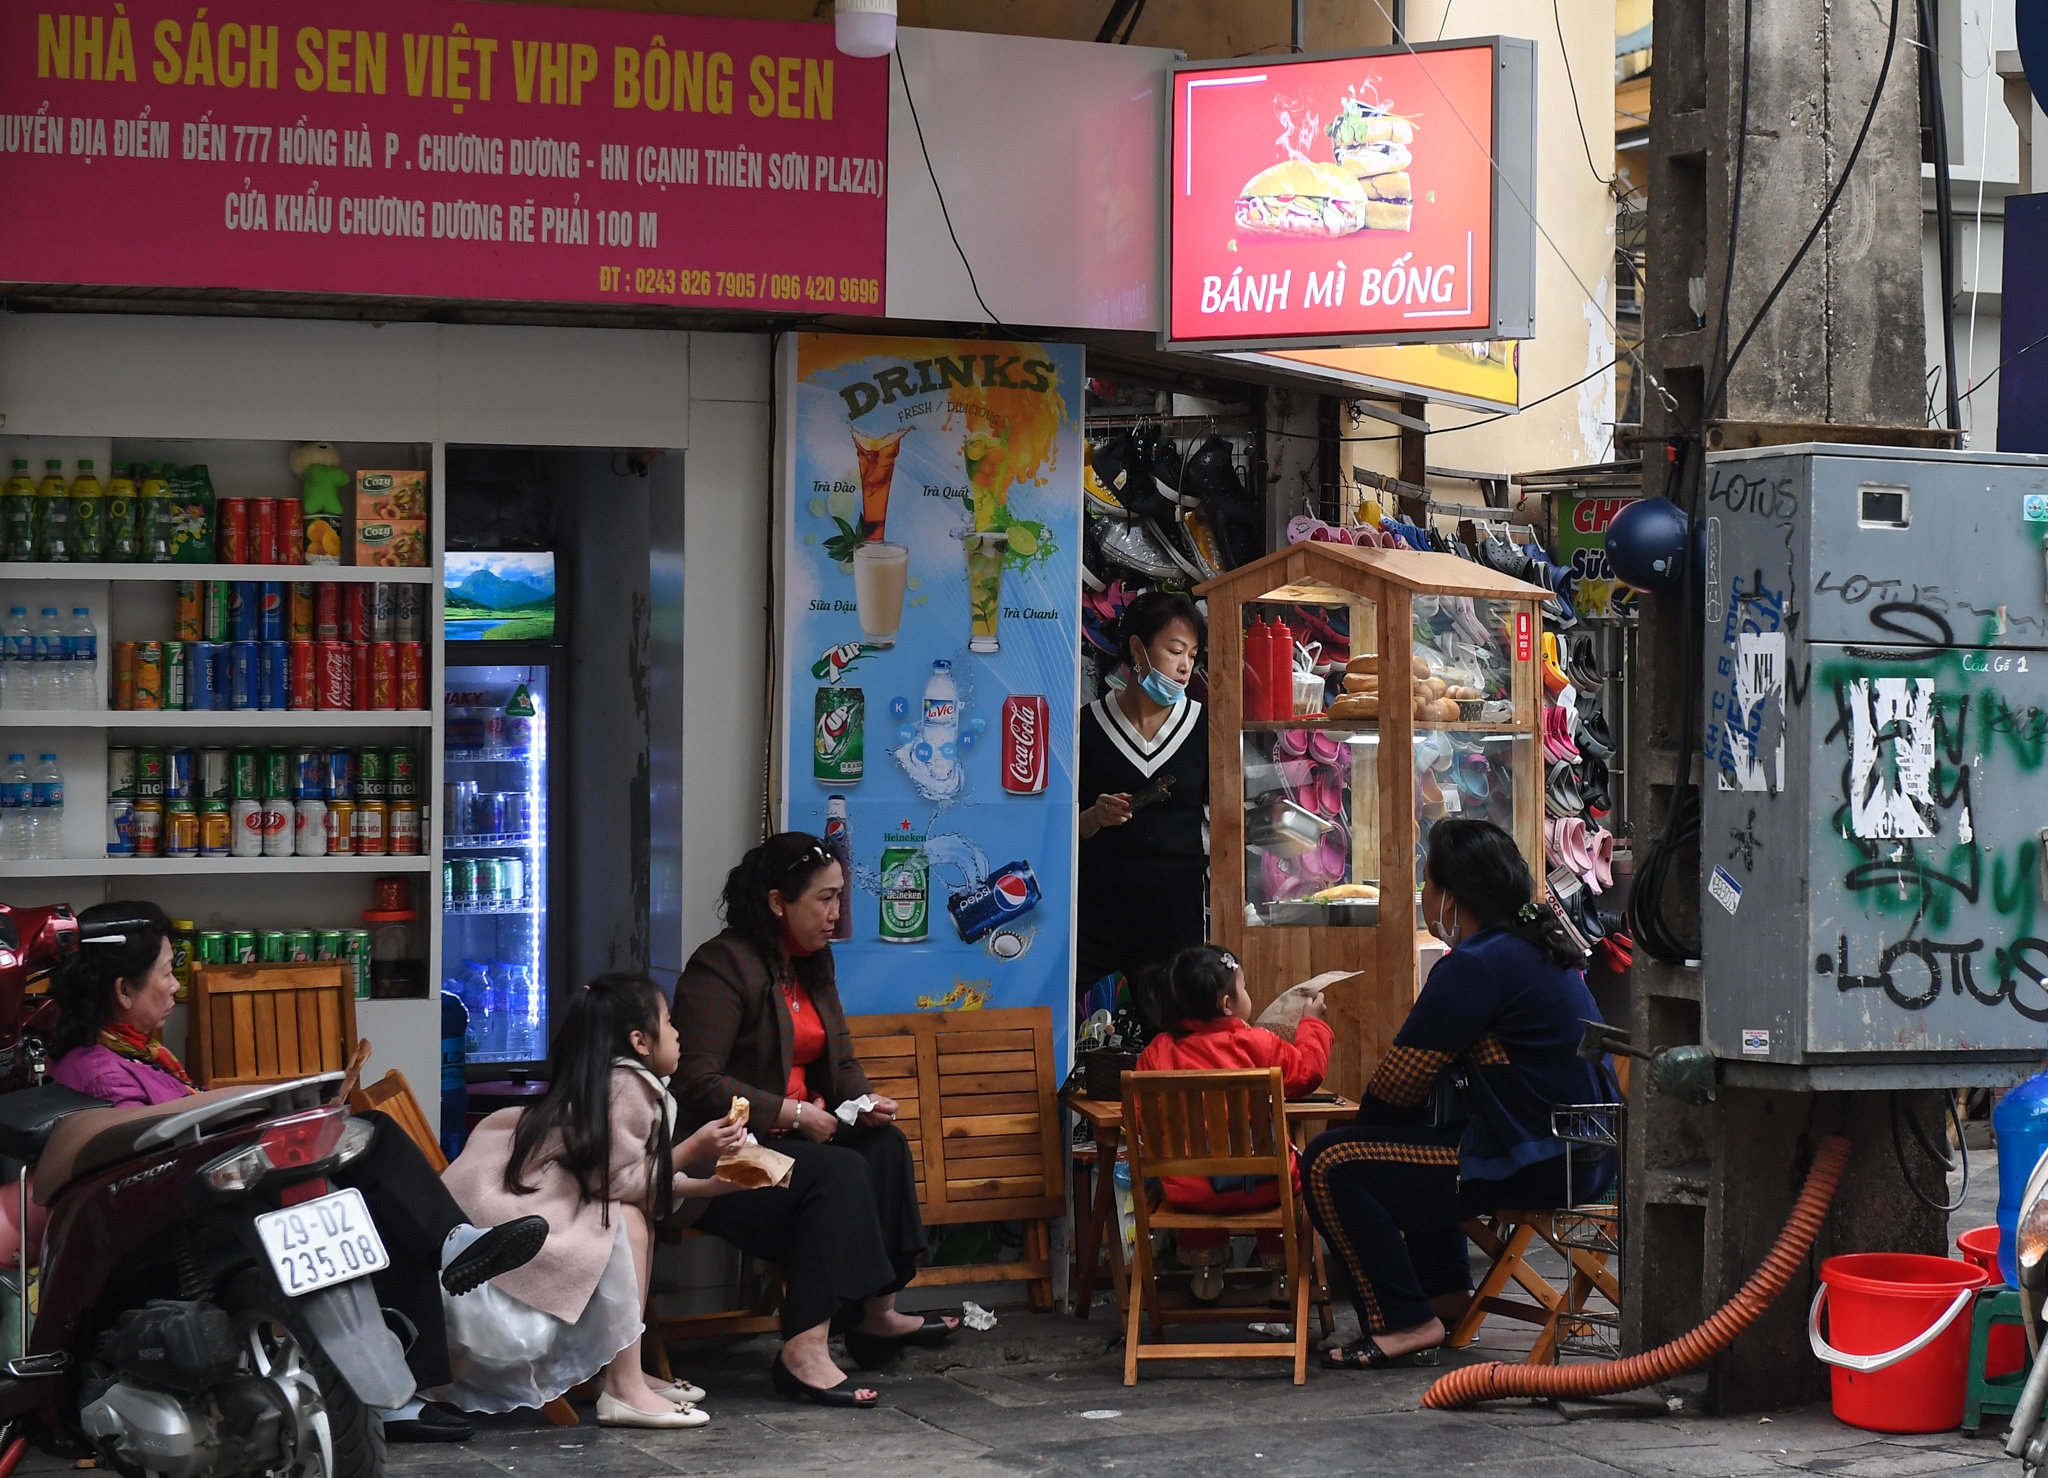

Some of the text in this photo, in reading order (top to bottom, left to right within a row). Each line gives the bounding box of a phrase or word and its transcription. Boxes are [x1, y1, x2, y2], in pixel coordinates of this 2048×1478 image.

[38, 3, 834, 121] NHÀ SÁCH SEN VIỆT VHP BÔNG SEN
[70, 117, 107, 165] ĐỊA
[113, 105, 170, 159] ĐIỂM
[182, 110, 227, 162] ĐẾN
[232, 126, 272, 163] 777
[279, 114, 337, 168] HỒNG
[344, 123, 373, 168] HÀ
[385, 132, 399, 169] P
[418, 133, 503, 176] CHƯƠNG
[510, 136, 580, 179] DƯƠNG
[600, 144, 630, 182] HN
[636, 145, 699, 192] (CẠNH
[705, 143, 762, 189] THIÊN
[768, 149, 809, 191] SƠN
[815, 155, 884, 198] PLAZA)
[225, 177, 658, 248] CỬA KHẨU CHƯƠNG DƯƠNG RẼ PHẢI 100 M
[599, 265, 621, 292] ĐT
[636, 268, 677, 296] 0243
[680, 271, 711, 297] 826
[716, 272, 757, 299] 7905
[771, 274, 801, 301] 096
[804, 275, 836, 303] 420
[839, 277, 879, 304] 9696
[1201, 251, 1456, 314] BÁNH MÌ BỐNG
[839, 355, 1056, 421] DRINKS
[897, 401, 933, 423] FRESH
[364, 477, 391, 488] Cozy
[812, 480, 856, 493] Trà Đào
[922, 485, 969, 499] Trà Quất
[1708, 470, 1798, 519] LOTUS
[364, 527, 391, 538] Cozy
[832, 600, 857, 613] Đậu
[1003, 607, 1058, 620] Trà Chanh
[1994, 656, 2012, 673] Gỗ
[2017, 656, 2029, 673] 1
[894, 703, 904, 713] K
[884, 832, 928, 842] Heineken
[887, 889, 923, 900] Heineken
[959, 886, 991, 912] pepsi
[274, 1201, 356, 1251] 29-D2
[281, 1234, 378, 1290] 235.08
